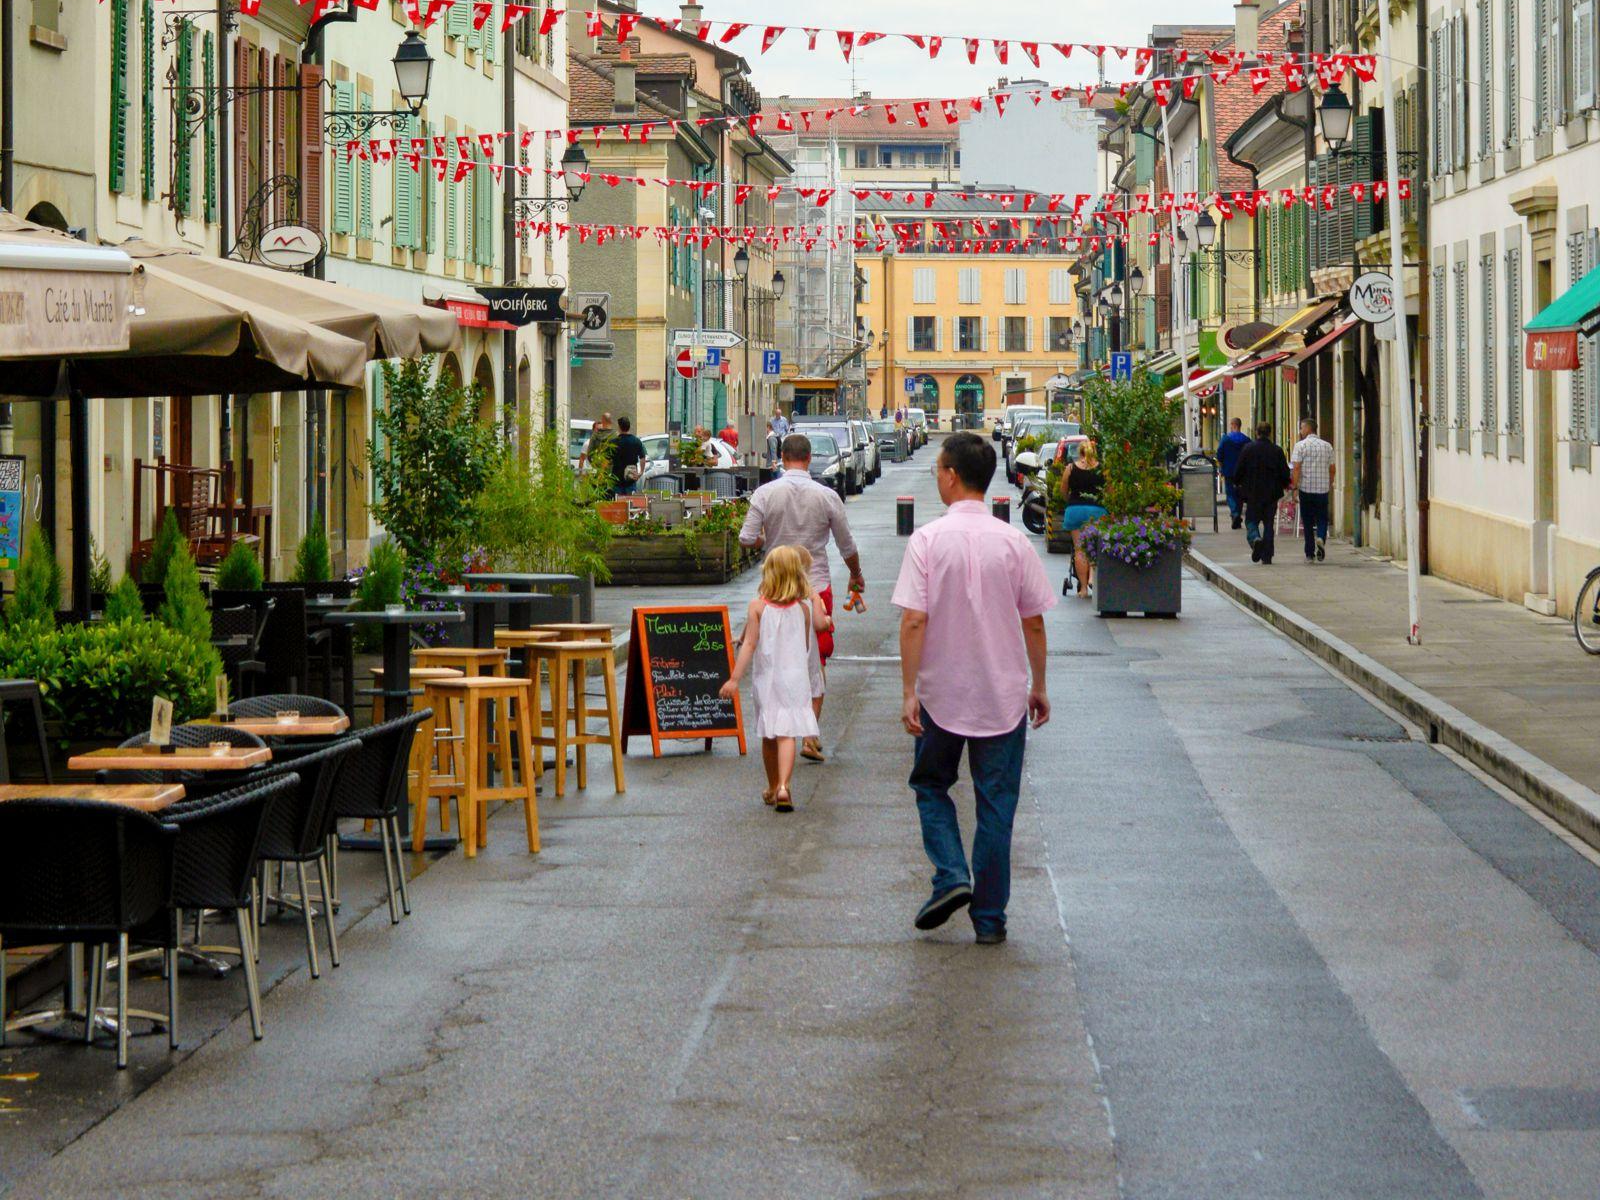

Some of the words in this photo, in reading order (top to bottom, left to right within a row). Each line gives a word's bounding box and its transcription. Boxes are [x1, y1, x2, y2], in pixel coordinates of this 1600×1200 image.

[45, 288, 70, 330] Café
[72, 288, 80, 322] du
[84, 289, 113, 323] Marché
[491, 293, 548, 318] WOLFISBERG
[768, 352, 776, 364] P
[1117, 356, 1126, 369] P
[645, 616, 678, 634] Menu
[680, 622, 699, 633] du
